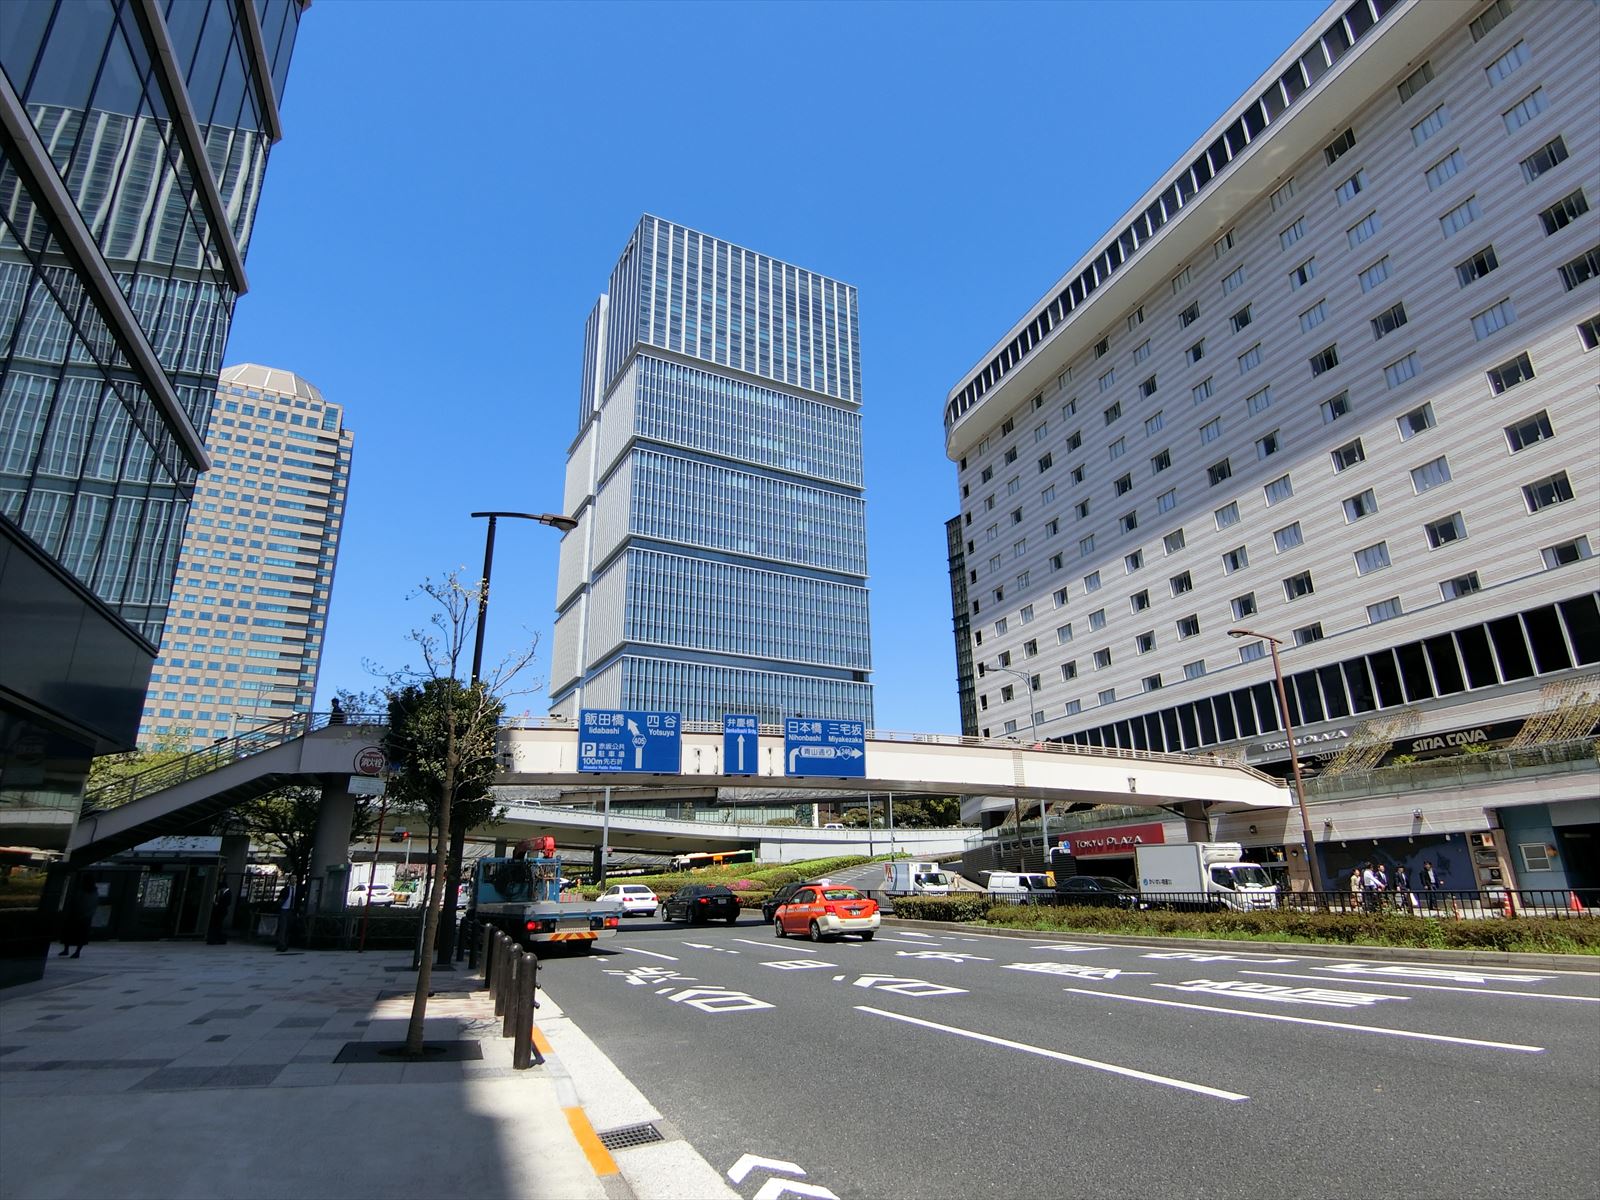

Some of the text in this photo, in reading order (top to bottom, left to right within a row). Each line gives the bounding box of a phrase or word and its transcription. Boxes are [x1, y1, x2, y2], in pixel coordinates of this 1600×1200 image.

[584, 712, 625, 727] 飯田橋
[646, 714, 677, 728] 四谷
[727, 718, 755, 728] 弁慶橋
[588, 727, 620, 735] Iidabashi
[648, 728, 675, 737] Yotsuya
[788, 721, 822, 735] 日本橋
[828, 723, 862, 736] 三宅坂
[634, 737, 645, 745] 405
[788, 734, 822, 742] Nihonbashi
[828, 735, 863, 744] Miyakezaka
[1303, 730, 1348, 744] PLAZA
[1445, 729, 1488, 746] COVA
[804, 748, 832, 756] 青山通り
[1075, 835, 1143, 849] TOKYU PLAZA
